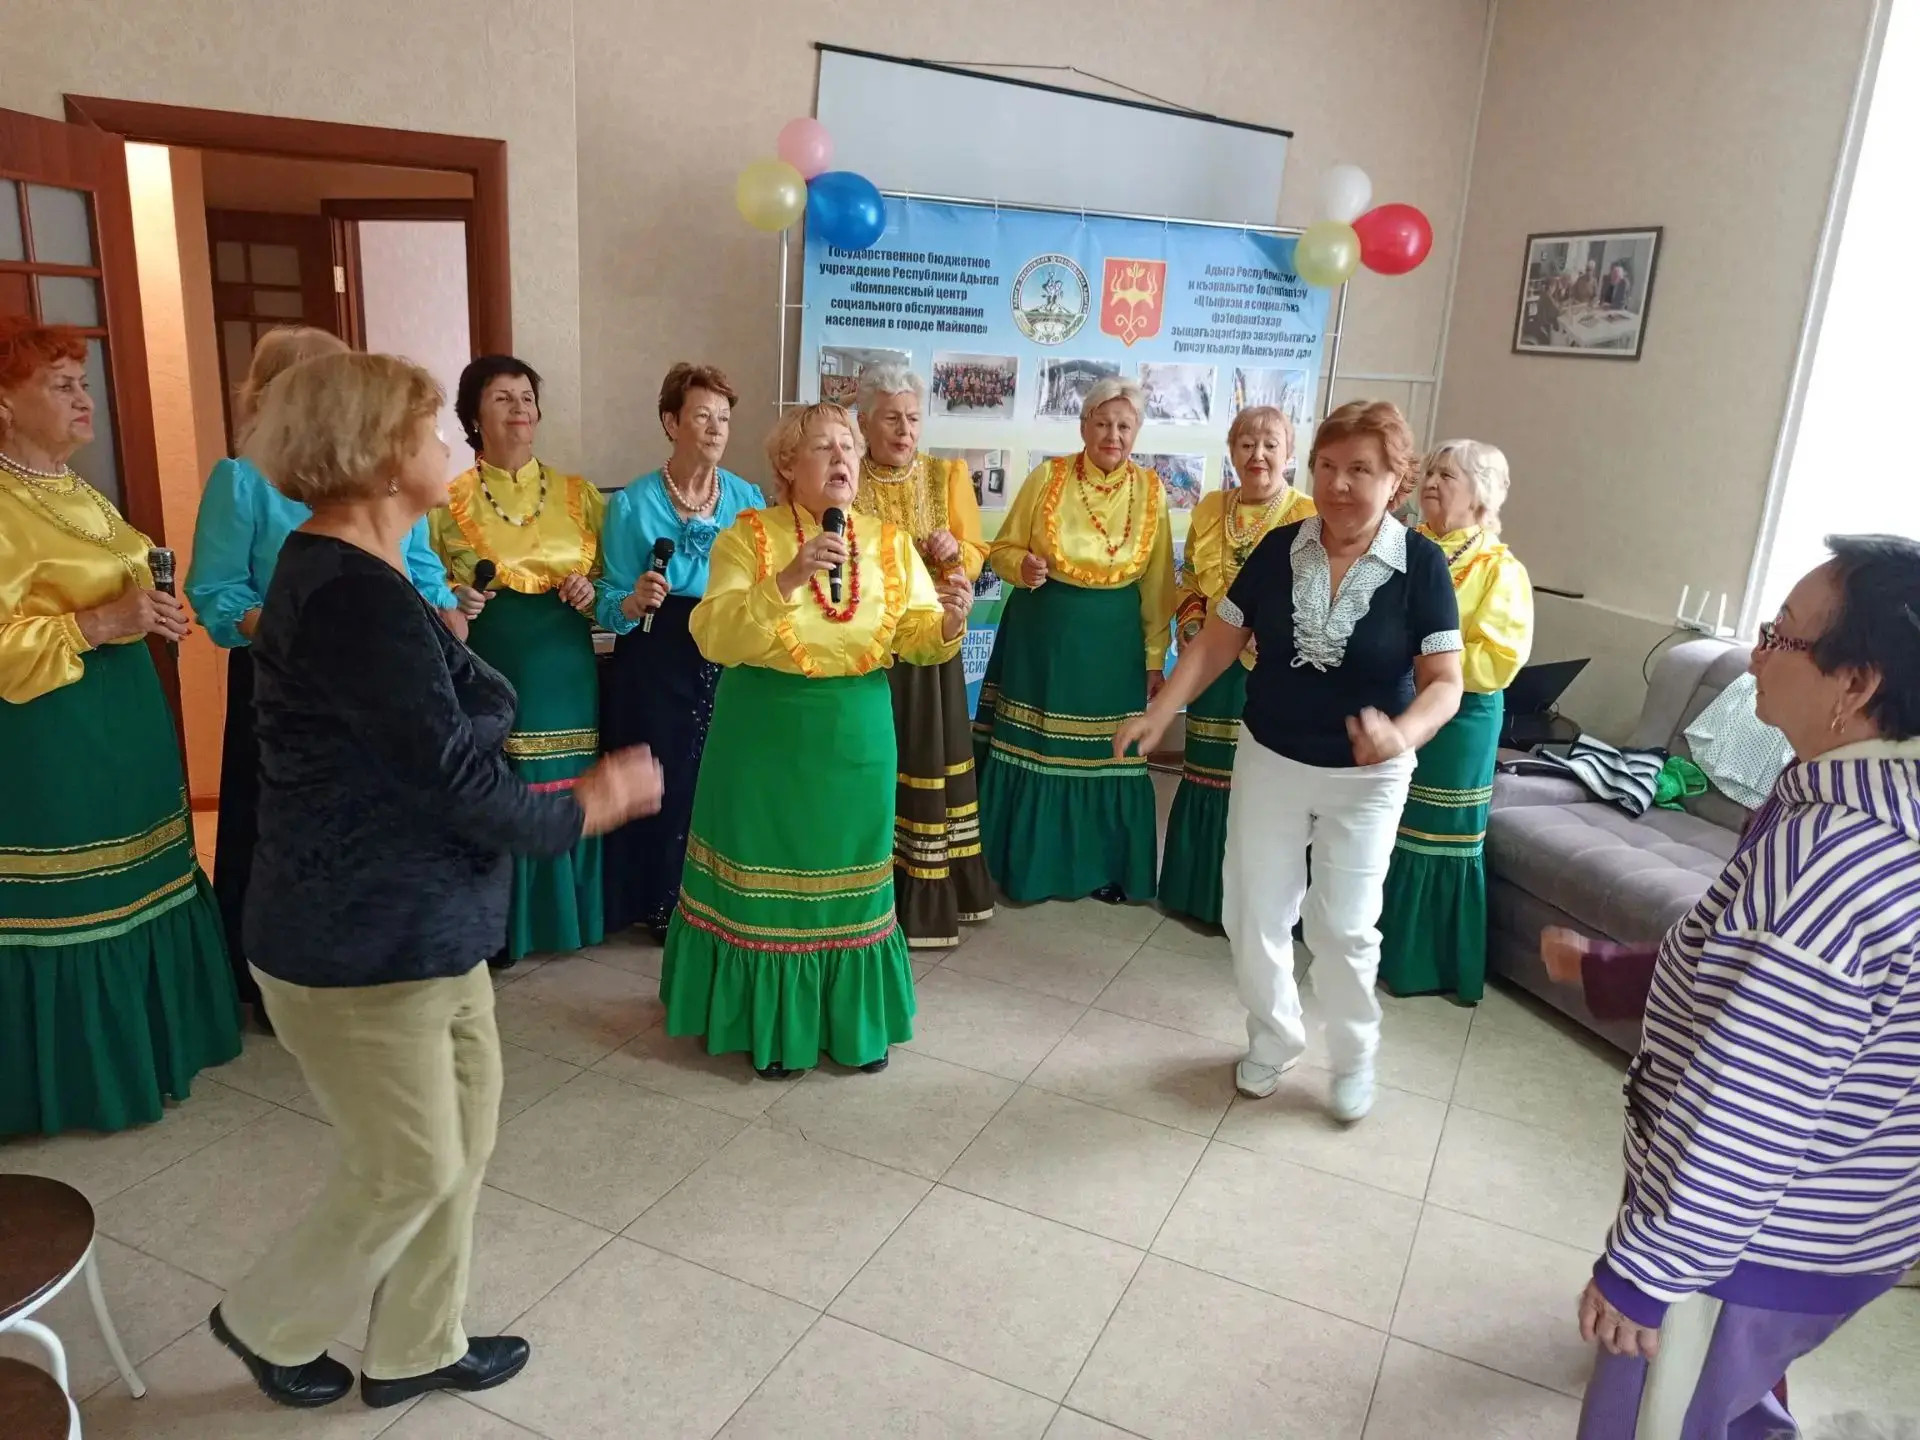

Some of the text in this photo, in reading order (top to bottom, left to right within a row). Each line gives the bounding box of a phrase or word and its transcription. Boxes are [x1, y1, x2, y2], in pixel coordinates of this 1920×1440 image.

[828, 245, 991, 269] Государственное бюджетное
[819, 262, 1000, 286] учреждение Республики Адыгея
[851, 281, 968, 301] «Комплексный центр
[830, 298, 985, 319] социального обслуживания
[825, 314, 988, 335] населения в городе Майкопе»
[962, 631, 992, 645] ЬНЫЕ
[961, 646, 991, 660] ЕКТЫ
[963, 661, 987, 673] ССИИ
